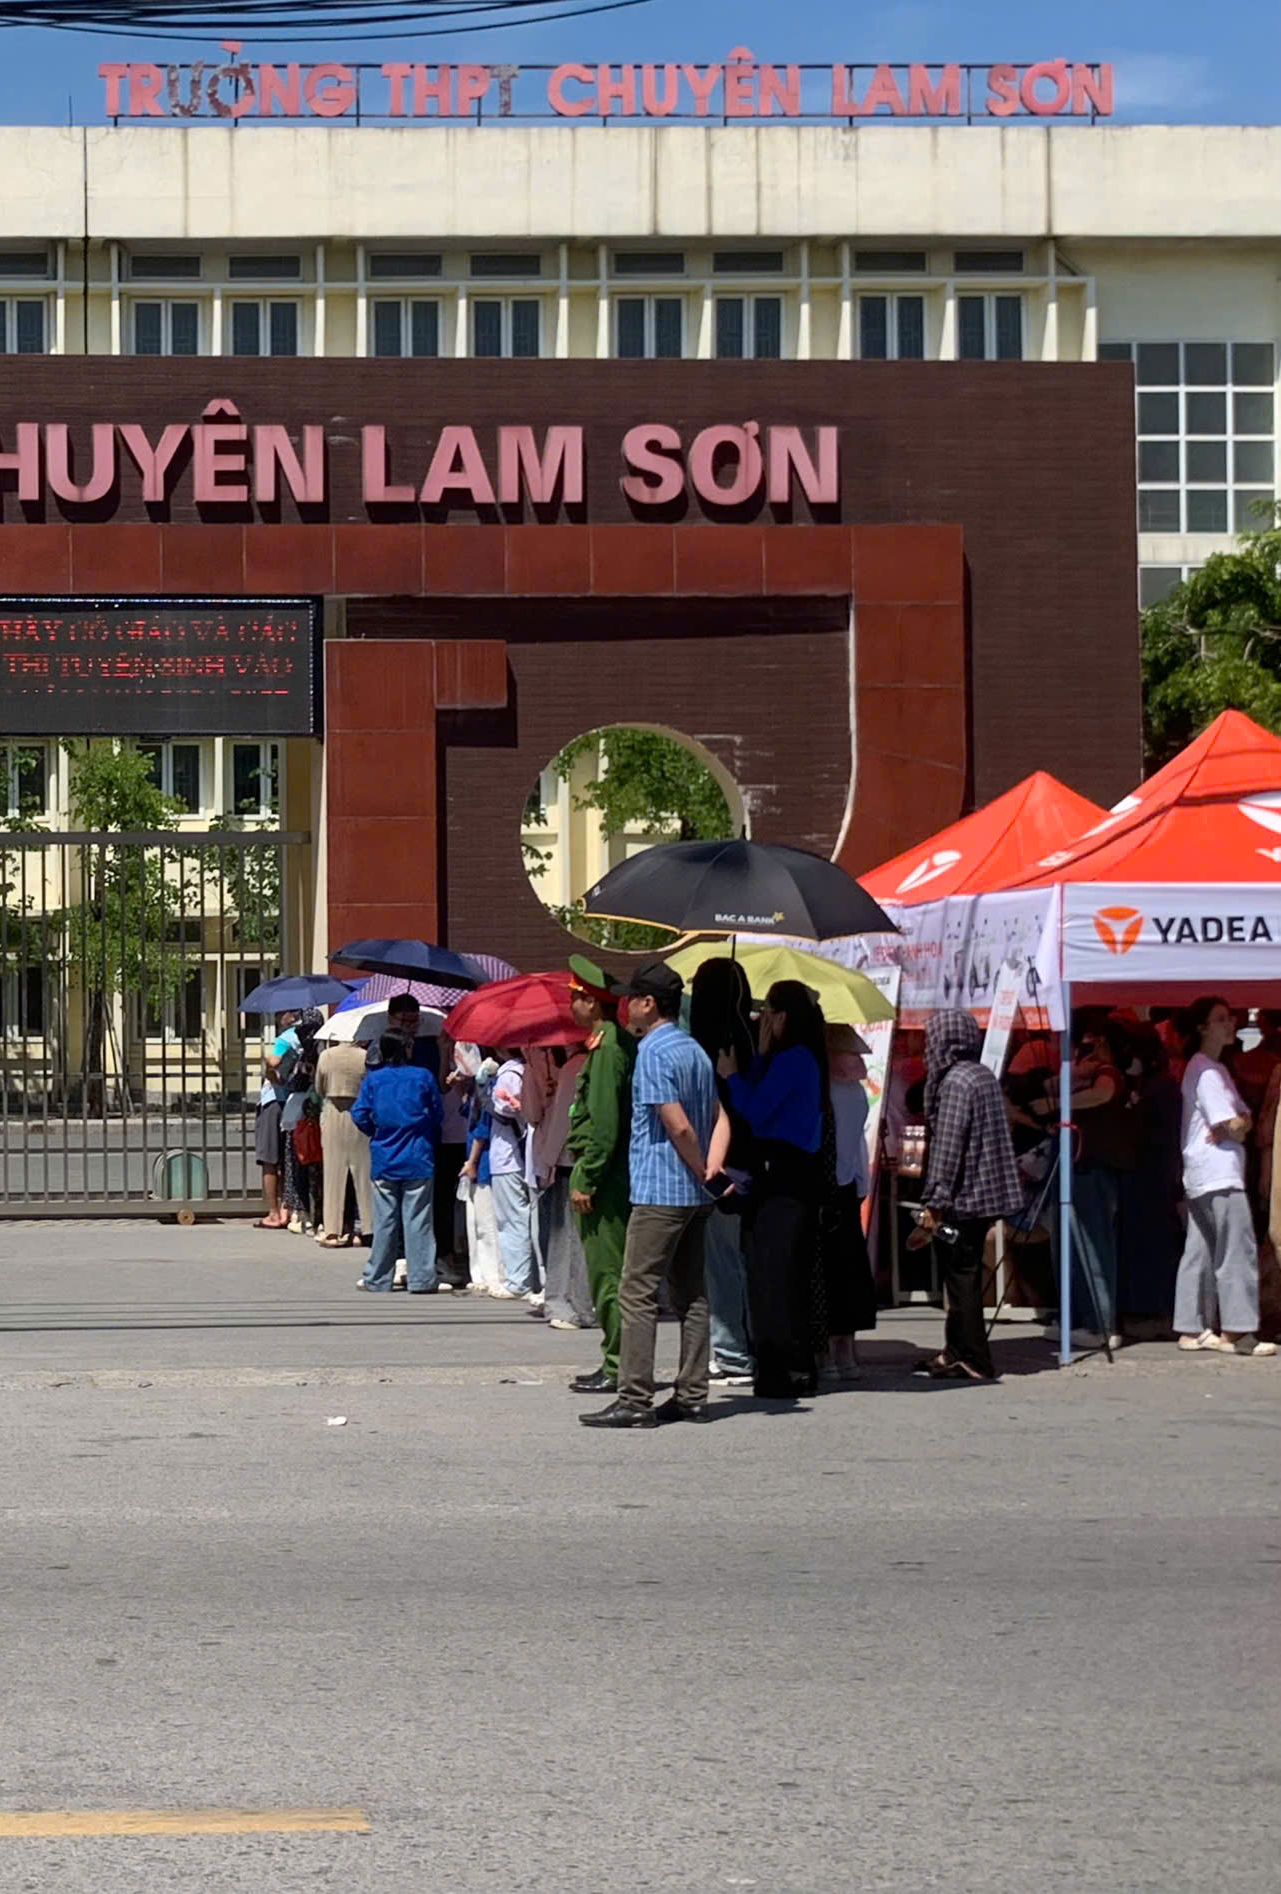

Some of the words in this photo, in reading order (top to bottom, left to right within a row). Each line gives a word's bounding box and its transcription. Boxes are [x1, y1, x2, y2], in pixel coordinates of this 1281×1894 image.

[381, 63, 519, 117] THPT
[548, 47, 800, 117] CHUYÊN
[832, 63, 961, 117] LAM
[986, 58, 1114, 117] SƠN
[362, 425, 583, 504] LAM
[621, 420, 839, 506] SƠN
[714, 913, 736, 923] BAC
[737, 914, 746, 923] A
[1152, 916, 1273, 944] YADEA
